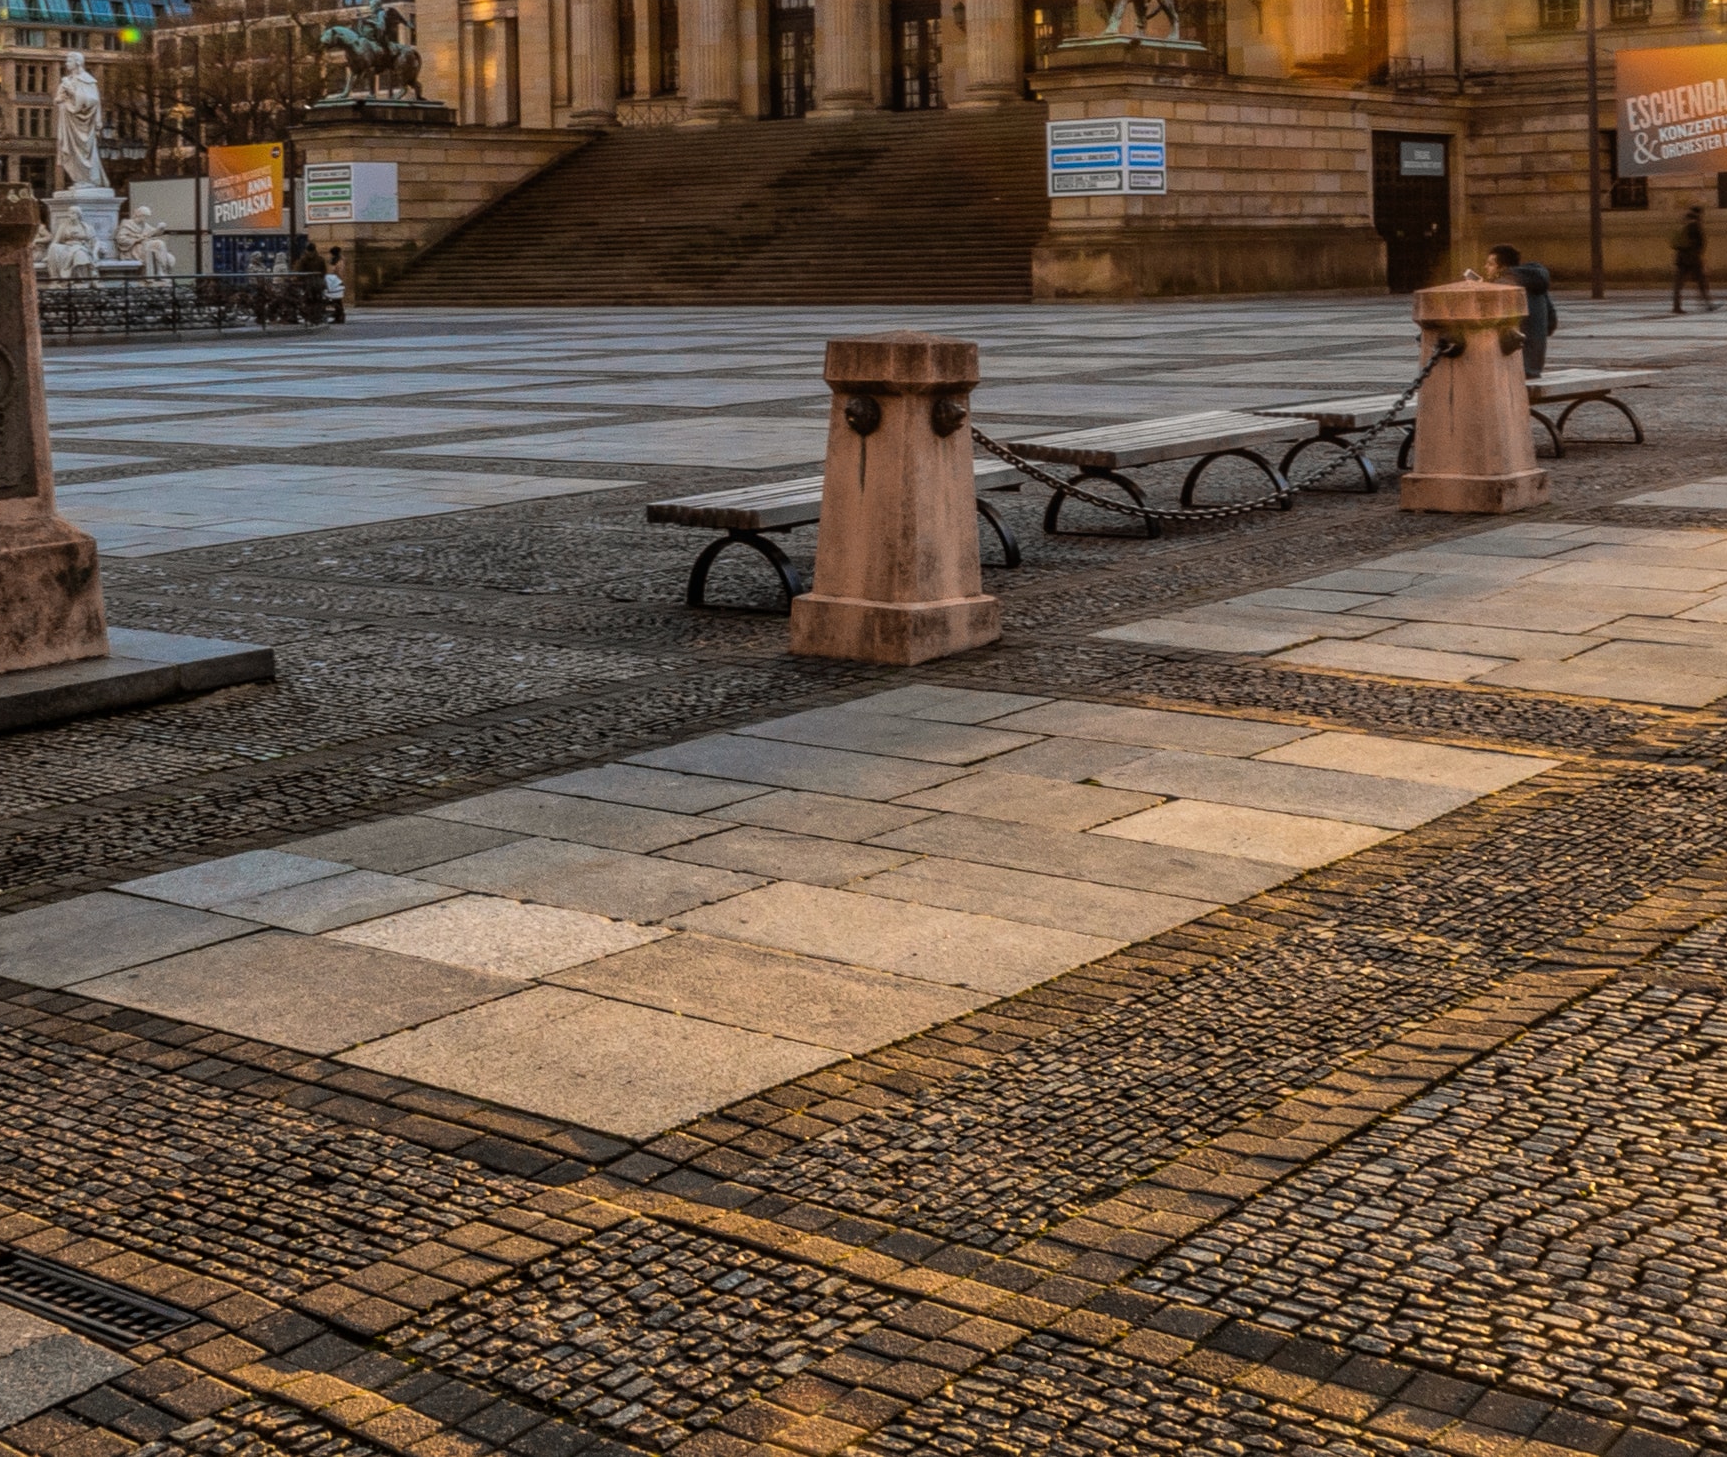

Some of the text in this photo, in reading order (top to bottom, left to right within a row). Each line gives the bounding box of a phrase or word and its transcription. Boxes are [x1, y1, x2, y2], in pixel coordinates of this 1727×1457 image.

[1633, 131, 1661, 165] &
[1661, 135, 1724, 160] ORCHESTER
[247, 175, 274, 196] ANNA
[213, 191, 275, 224] PROHASKA
